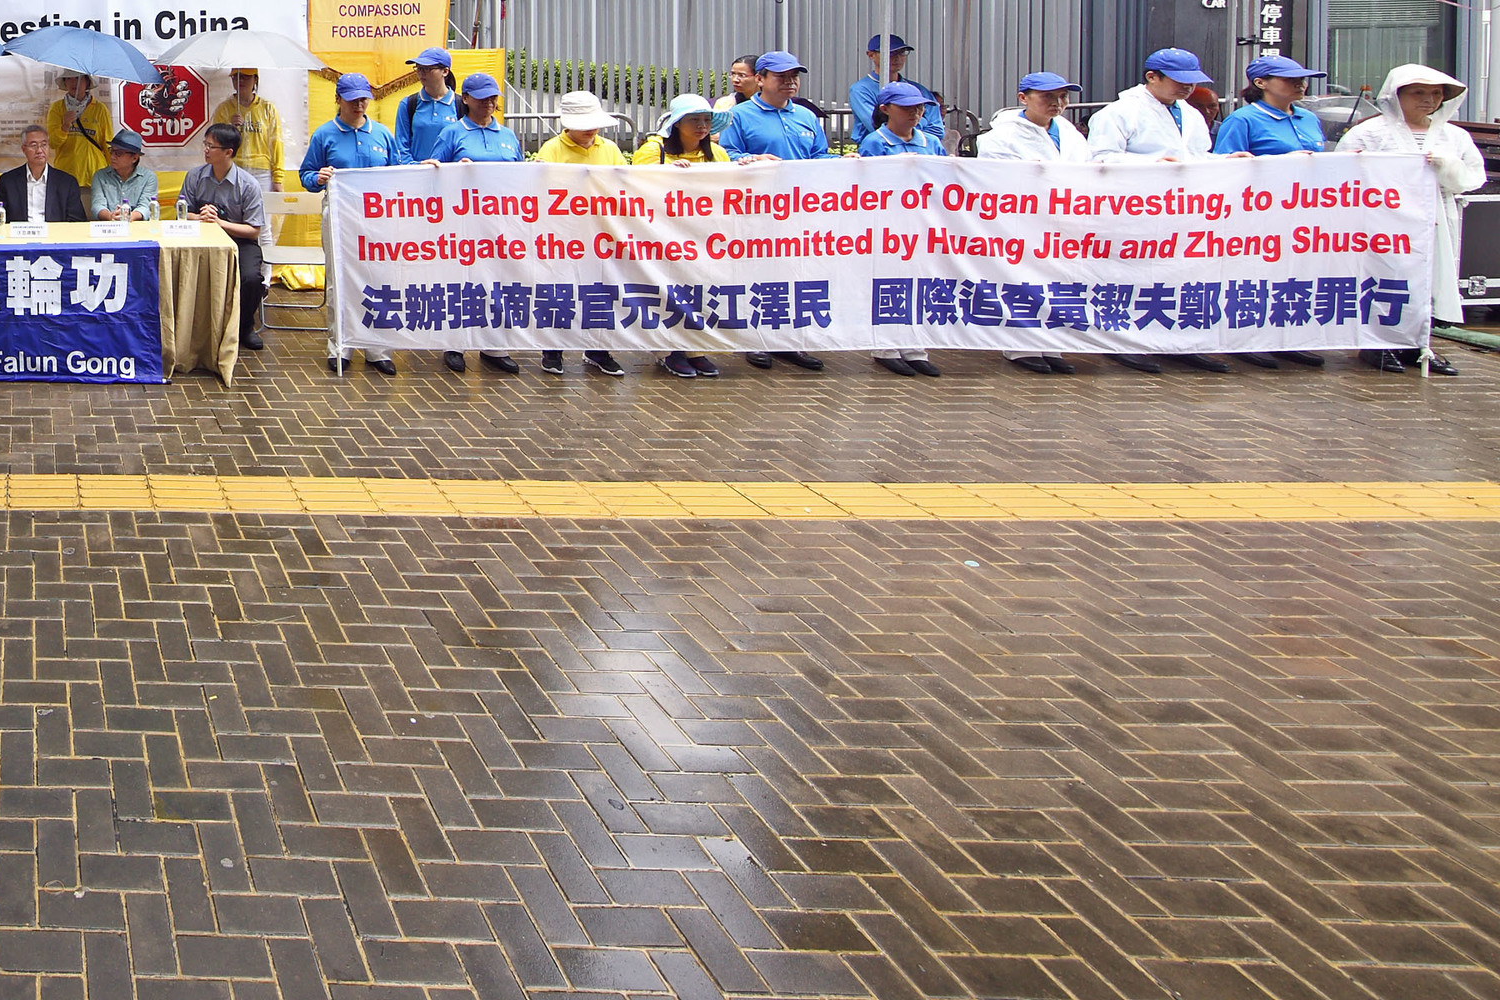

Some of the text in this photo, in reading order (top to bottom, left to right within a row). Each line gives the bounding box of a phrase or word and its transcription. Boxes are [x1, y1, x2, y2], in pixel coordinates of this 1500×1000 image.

[339, 3, 421, 17] COMPASSION
[114, 12, 142, 40] in
[332, 24, 426, 38] FORBEARANCE
[140, 118, 194, 136] STOP
[364, 180, 1400, 223] Bring Jiang Zemin, the Ringleader of Organ Harvesting, to Justice
[358, 226, 1411, 266] Investigate the Crimes Committed by Huang Jiefu and Zheng Shusen
[362, 277, 1410, 331] 法辦強摘器官元兇江澤民 國際追查黃潔夫鄭樹森罪行
[67, 350, 136, 379] Gong
